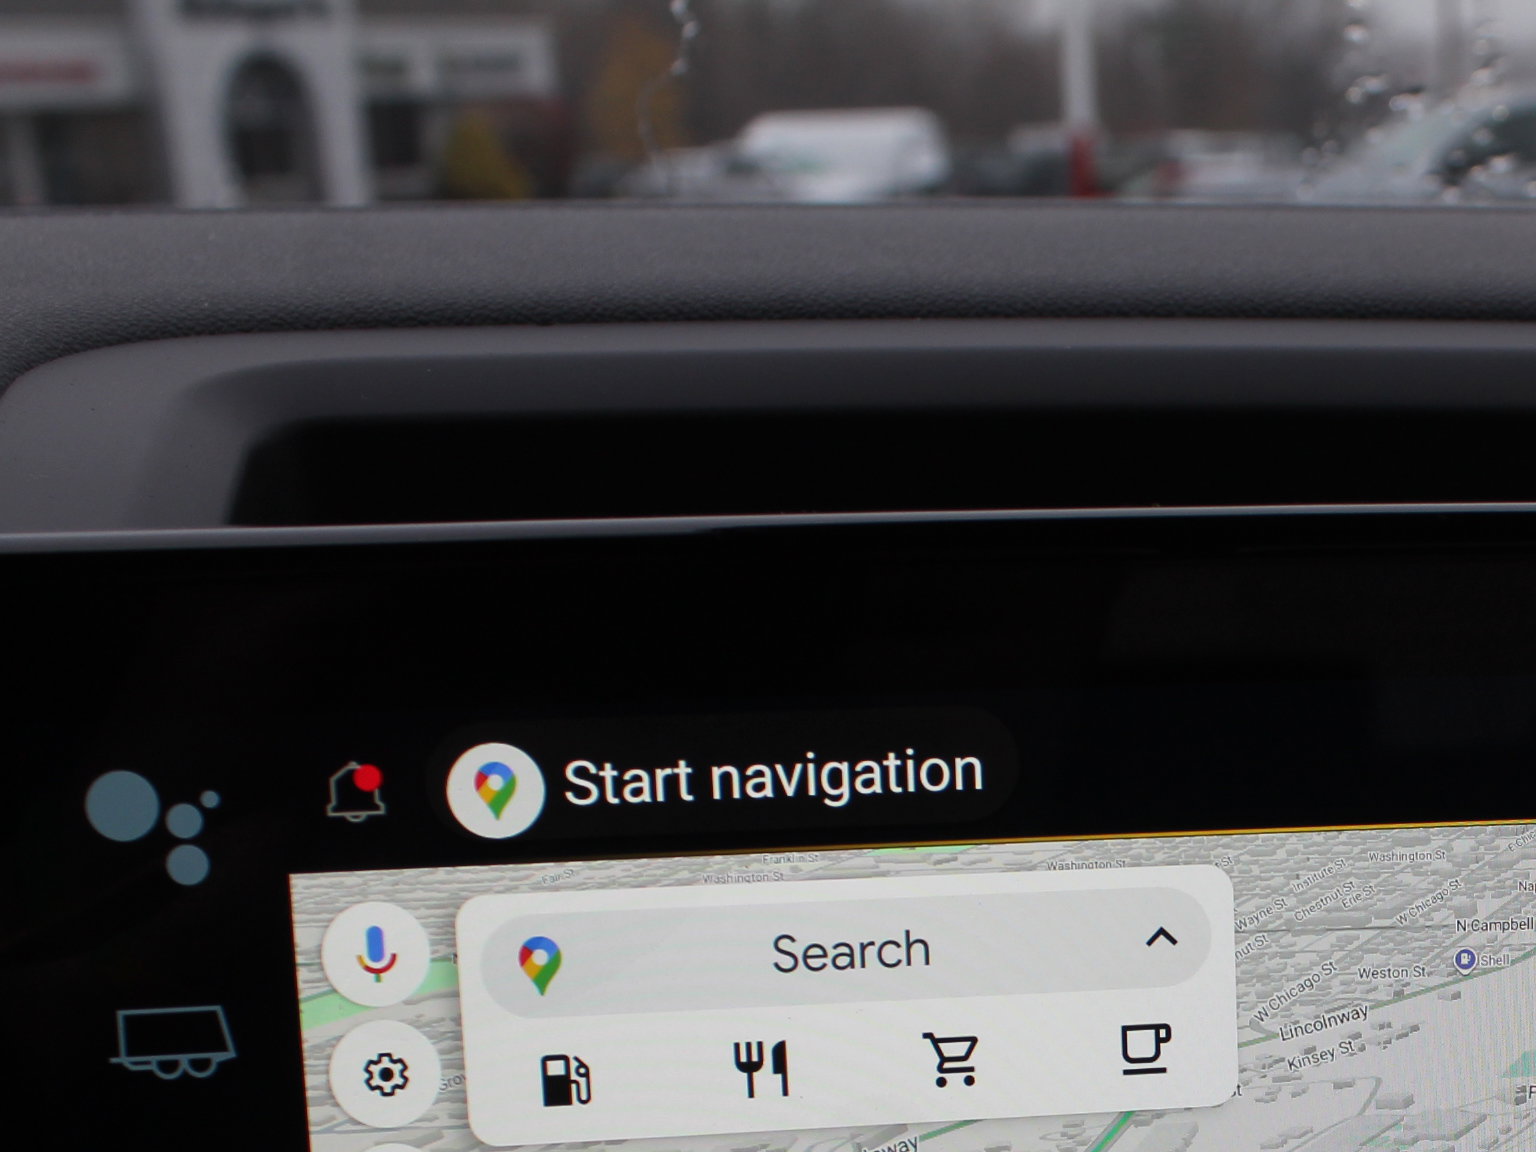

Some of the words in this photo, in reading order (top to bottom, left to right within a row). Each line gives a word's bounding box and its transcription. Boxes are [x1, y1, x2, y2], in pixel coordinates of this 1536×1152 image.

[565, 757, 694, 805] Start
[711, 749, 983, 807] navigation
[1368, 850, 1428, 864] Washington
[1430, 850, 1446, 861] St
[1292, 864, 1333, 892] Institute
[1332, 858, 1347, 874] St
[1293, 886, 1343, 922] Chestnut
[1341, 881, 1356, 896] St
[1341, 892, 1361, 909] Erie
[1360, 884, 1377, 899] St
[1396, 913, 1409, 926] W
[1407, 888, 1449, 920] Chicago
[1448, 879, 1463, 894] St
[1235, 903, 1275, 931] Wayne
[1274, 898, 1289, 912] St
[1456, 919, 1469, 932] N
[1471, 918, 1535, 934] Campbell
[771, 930, 931, 974] Search
[1254, 934, 1270, 951] St
[1358, 968, 1409, 980] Weston
[1412, 966, 1427, 978] St
[1481, 954, 1510, 967] Shell
[1254, 1007, 1270, 1024] W
[1268, 972, 1323, 1012] Chicago
[1321, 960, 1338, 977] St
[1279, 1005, 1369, 1042] Lincolnway
[1287, 1047, 1336, 1071] Kinsey
[1337, 1040, 1355, 1056] St
